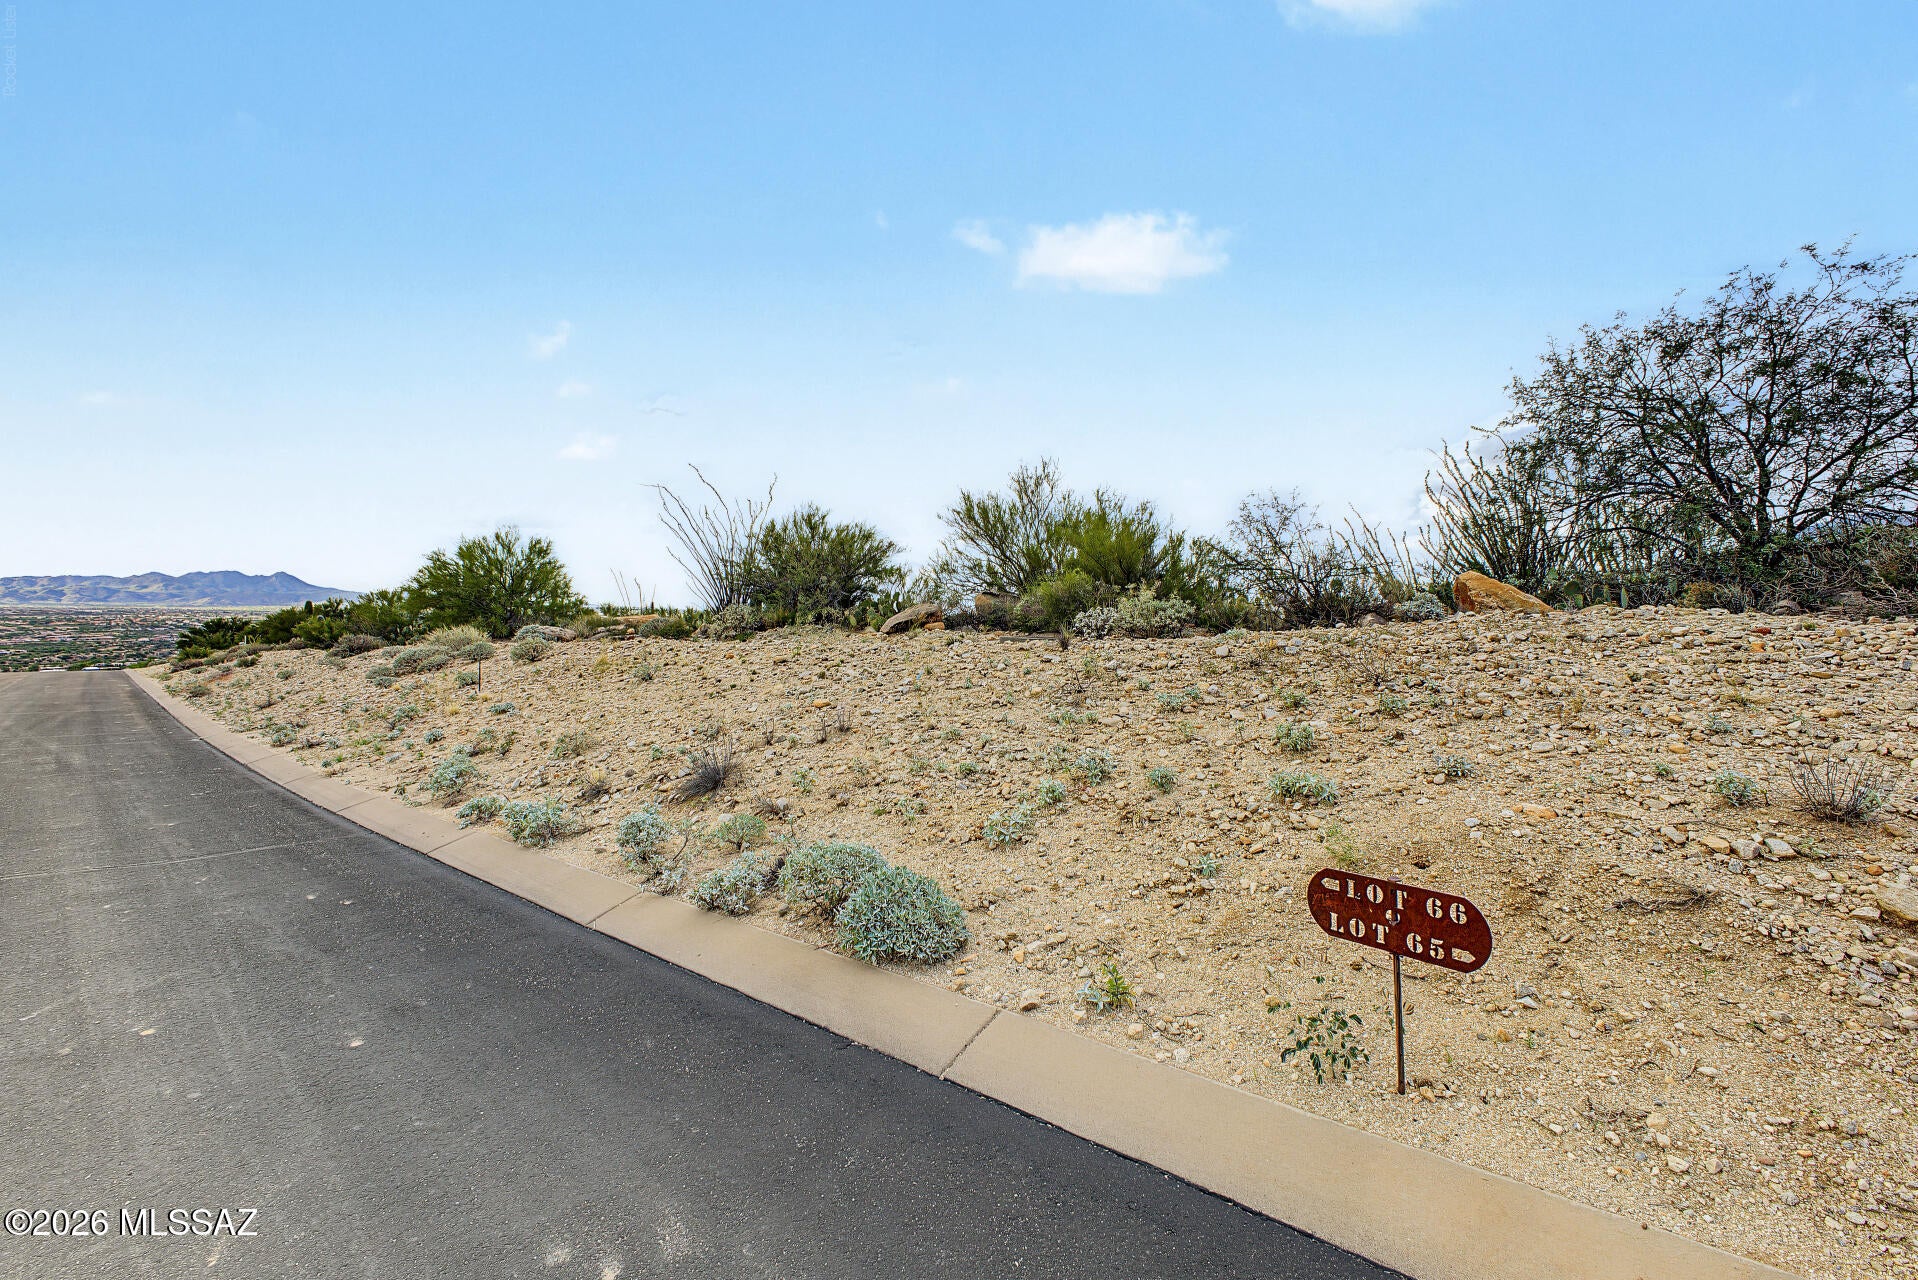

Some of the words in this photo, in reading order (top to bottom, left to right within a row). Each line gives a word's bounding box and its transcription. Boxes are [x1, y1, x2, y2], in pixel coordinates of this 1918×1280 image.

[1346, 878, 1407, 911] LOT
[1425, 897, 1468, 925] 66
[1329, 911, 1390, 945] LOT
[1406, 932, 1445, 960] 65
